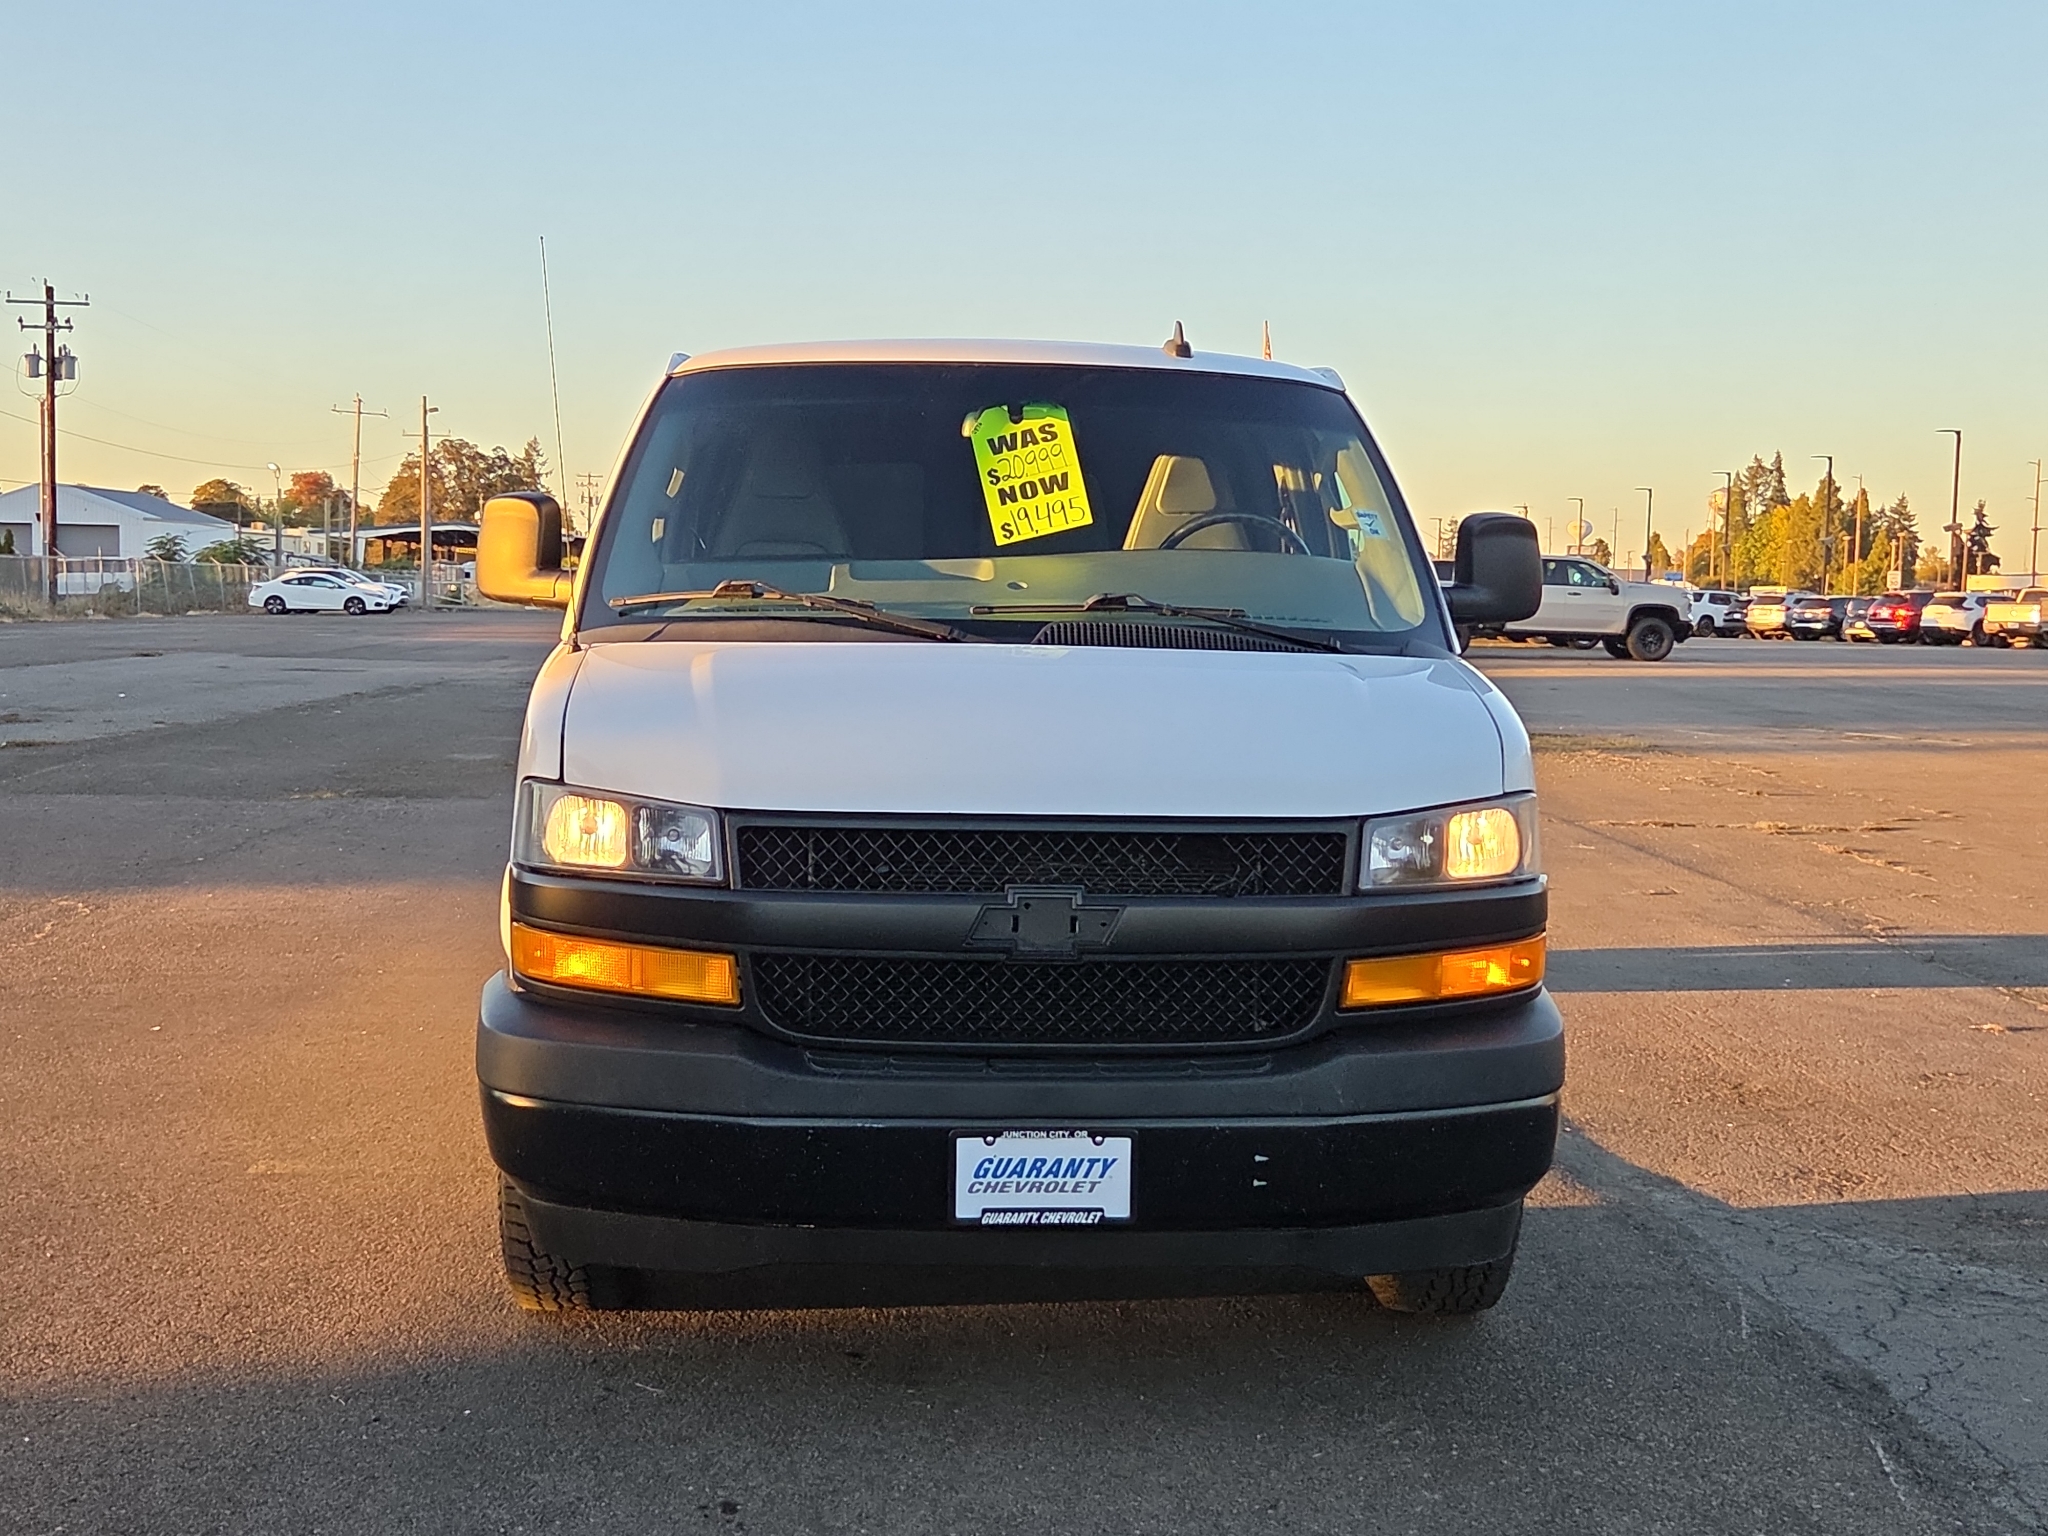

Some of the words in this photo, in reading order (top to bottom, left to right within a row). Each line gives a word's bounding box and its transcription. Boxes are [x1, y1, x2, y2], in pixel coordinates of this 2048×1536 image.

[986, 423, 1058, 456] WAS
[997, 472, 1069, 506] NOW
[1000, 496, 1085, 540] $19,495
[1001, 1130, 1047, 1138] JUNCTION
[1074, 1130, 1089, 1138] OR
[973, 1157, 1118, 1179] GUARANTY
[967, 1181, 1102, 1193] CHEVROLET
[1040, 1211, 1103, 1224] CHEVROLET
